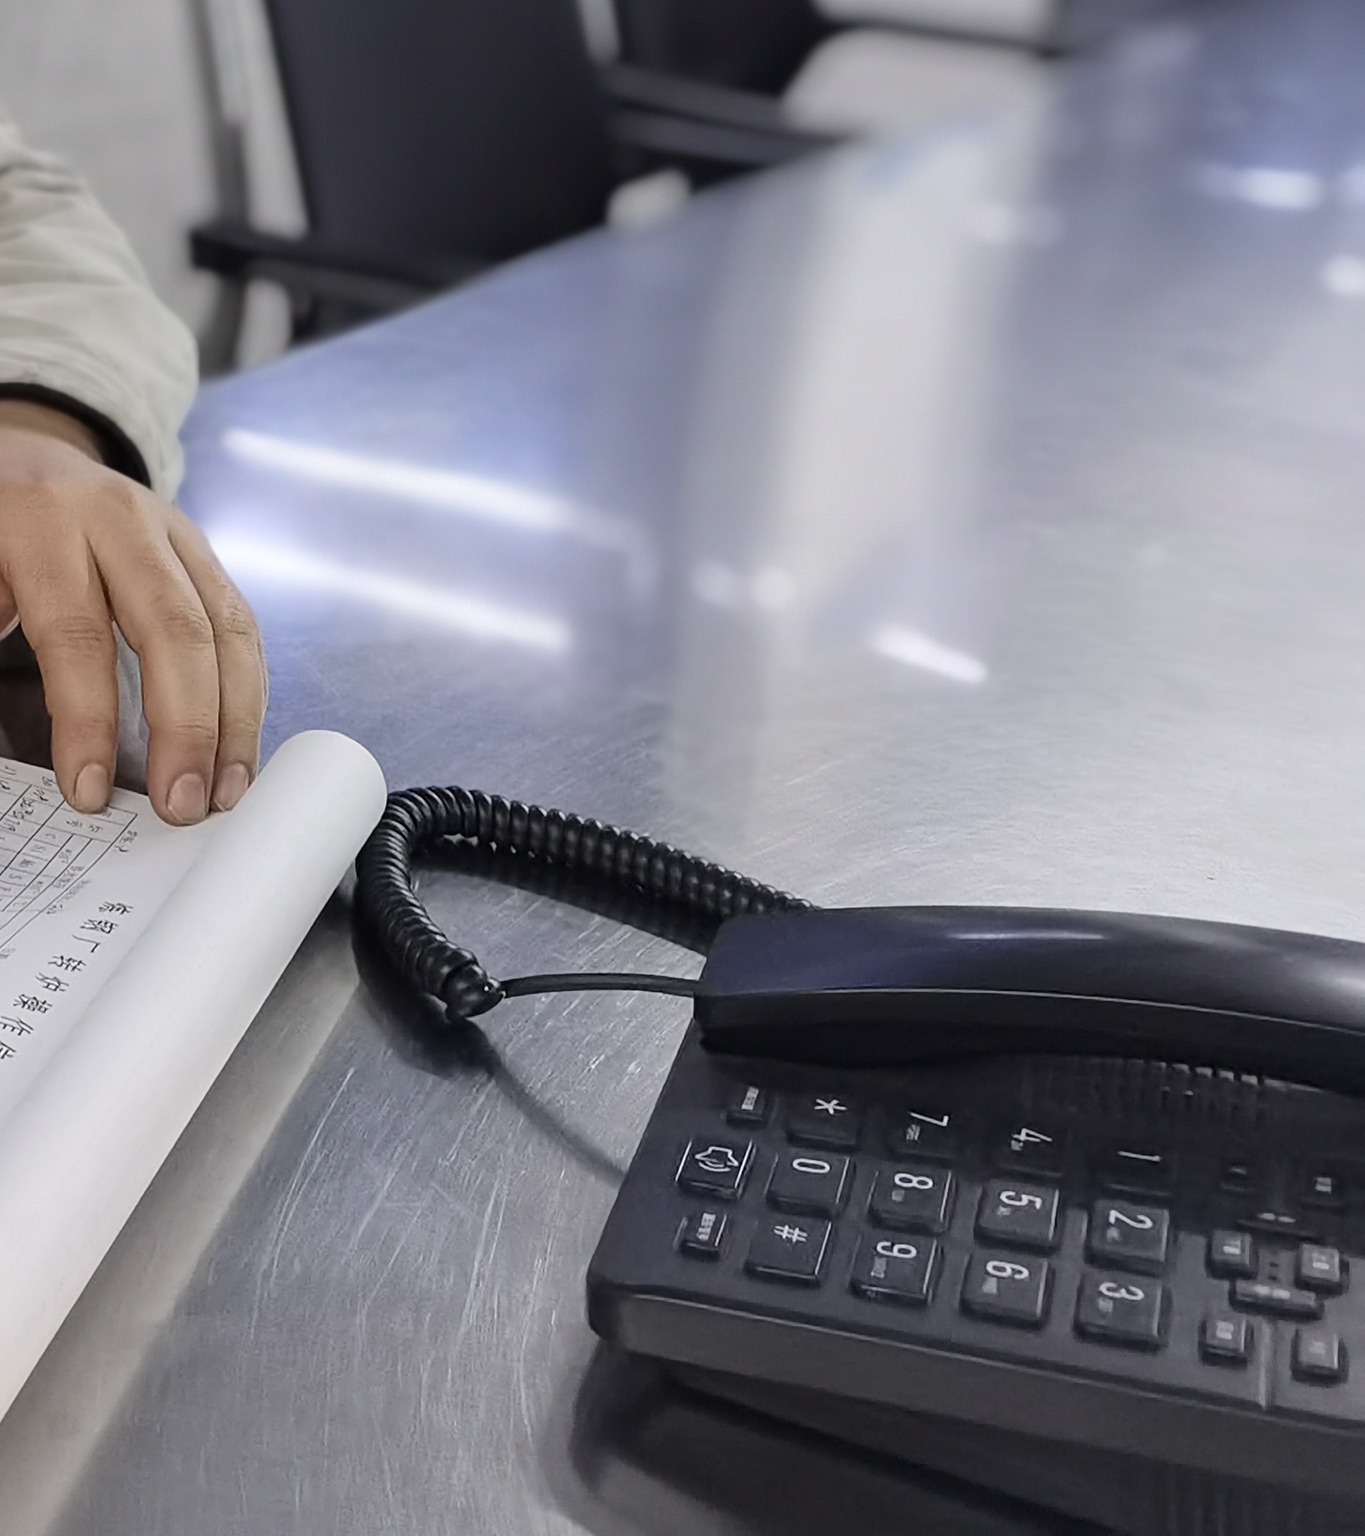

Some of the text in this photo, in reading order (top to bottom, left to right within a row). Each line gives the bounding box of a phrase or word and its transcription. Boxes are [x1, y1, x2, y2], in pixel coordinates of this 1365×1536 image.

[909, 1112, 950, 1128] 7
[1011, 1127, 1053, 1142] 4
[1117, 1150, 1162, 1162] 1
[791, 1157, 831, 1175] 0
[893, 1172, 934, 1191] 8
[999, 1190, 1042, 1210] 5
[1108, 1209, 1154, 1230] 2
[876, 1240, 918, 1260] 9
[985, 1260, 1029, 1280] 6
[1098, 1281, 1145, 1302] 3
